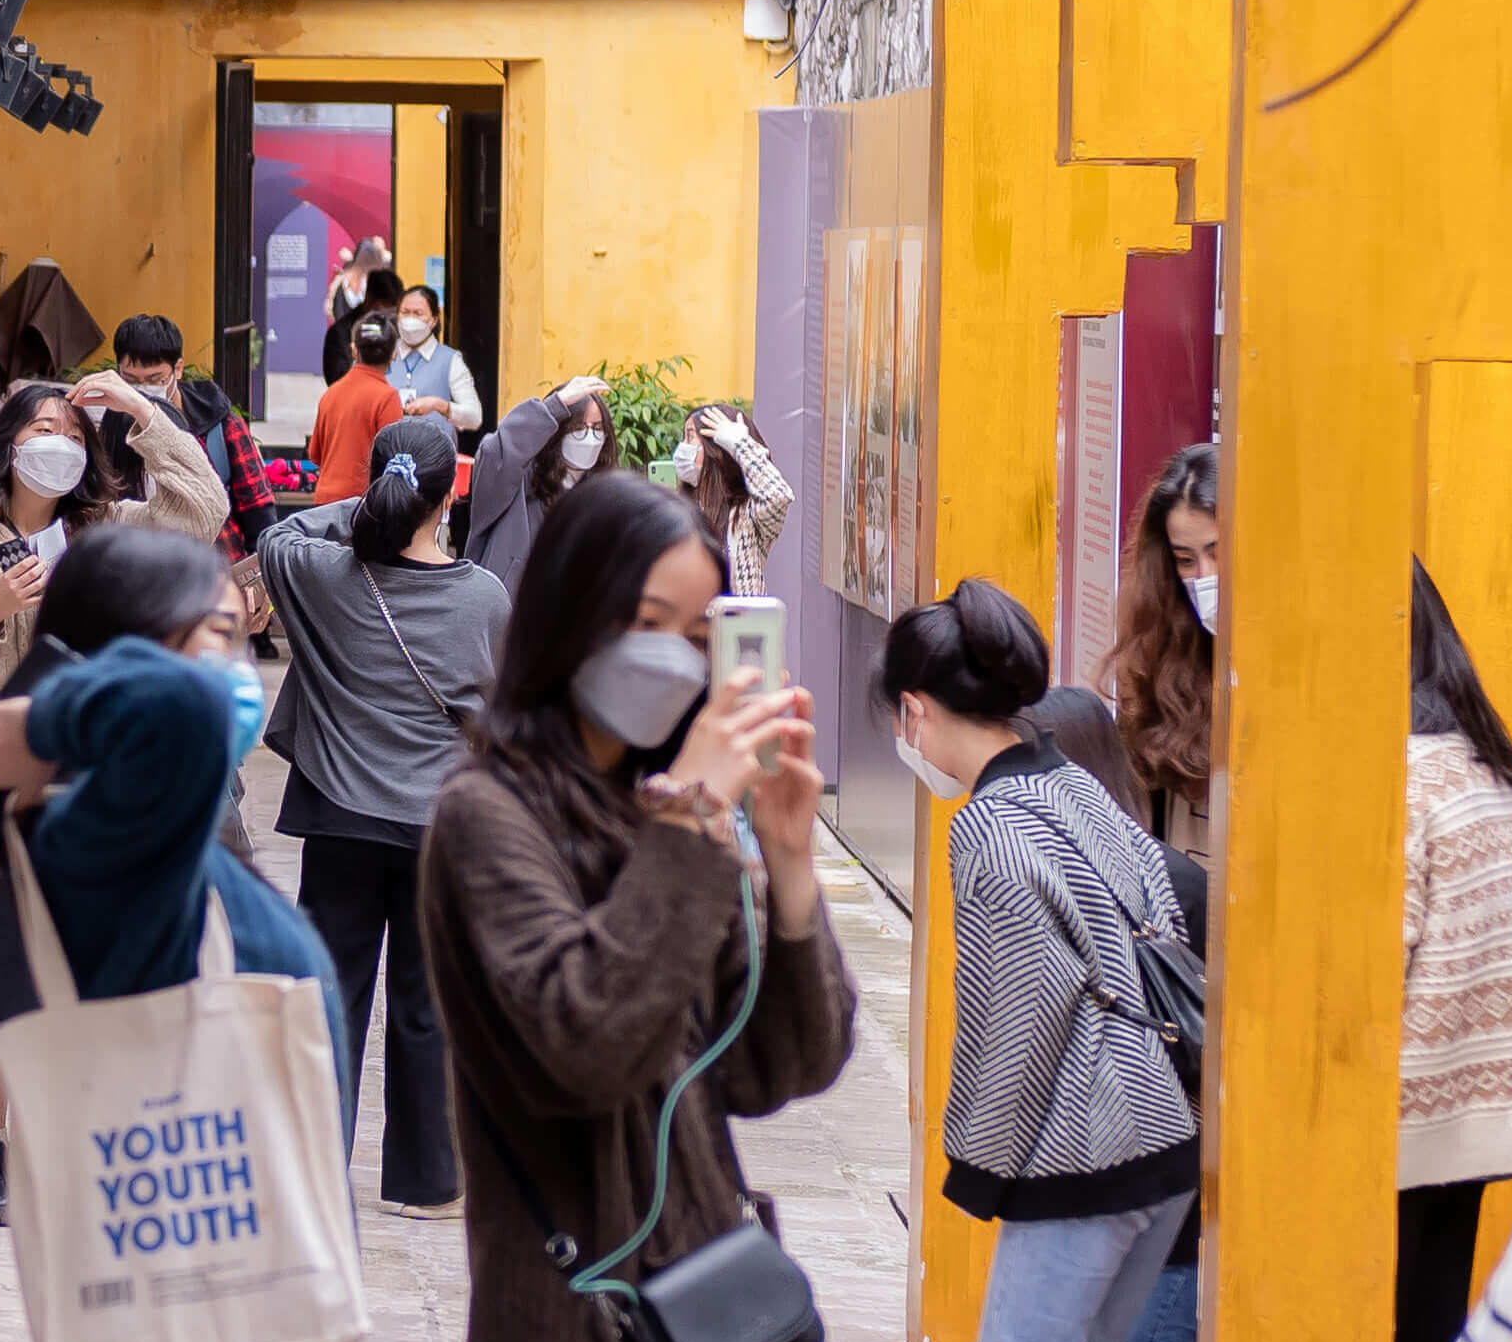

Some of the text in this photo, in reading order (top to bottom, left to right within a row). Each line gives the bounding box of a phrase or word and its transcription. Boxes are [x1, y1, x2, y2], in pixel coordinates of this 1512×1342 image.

[89, 1107, 247, 1167] YOUTH
[95, 1155, 252, 1214] YOUTH
[103, 1201, 260, 1258] YOUTH
